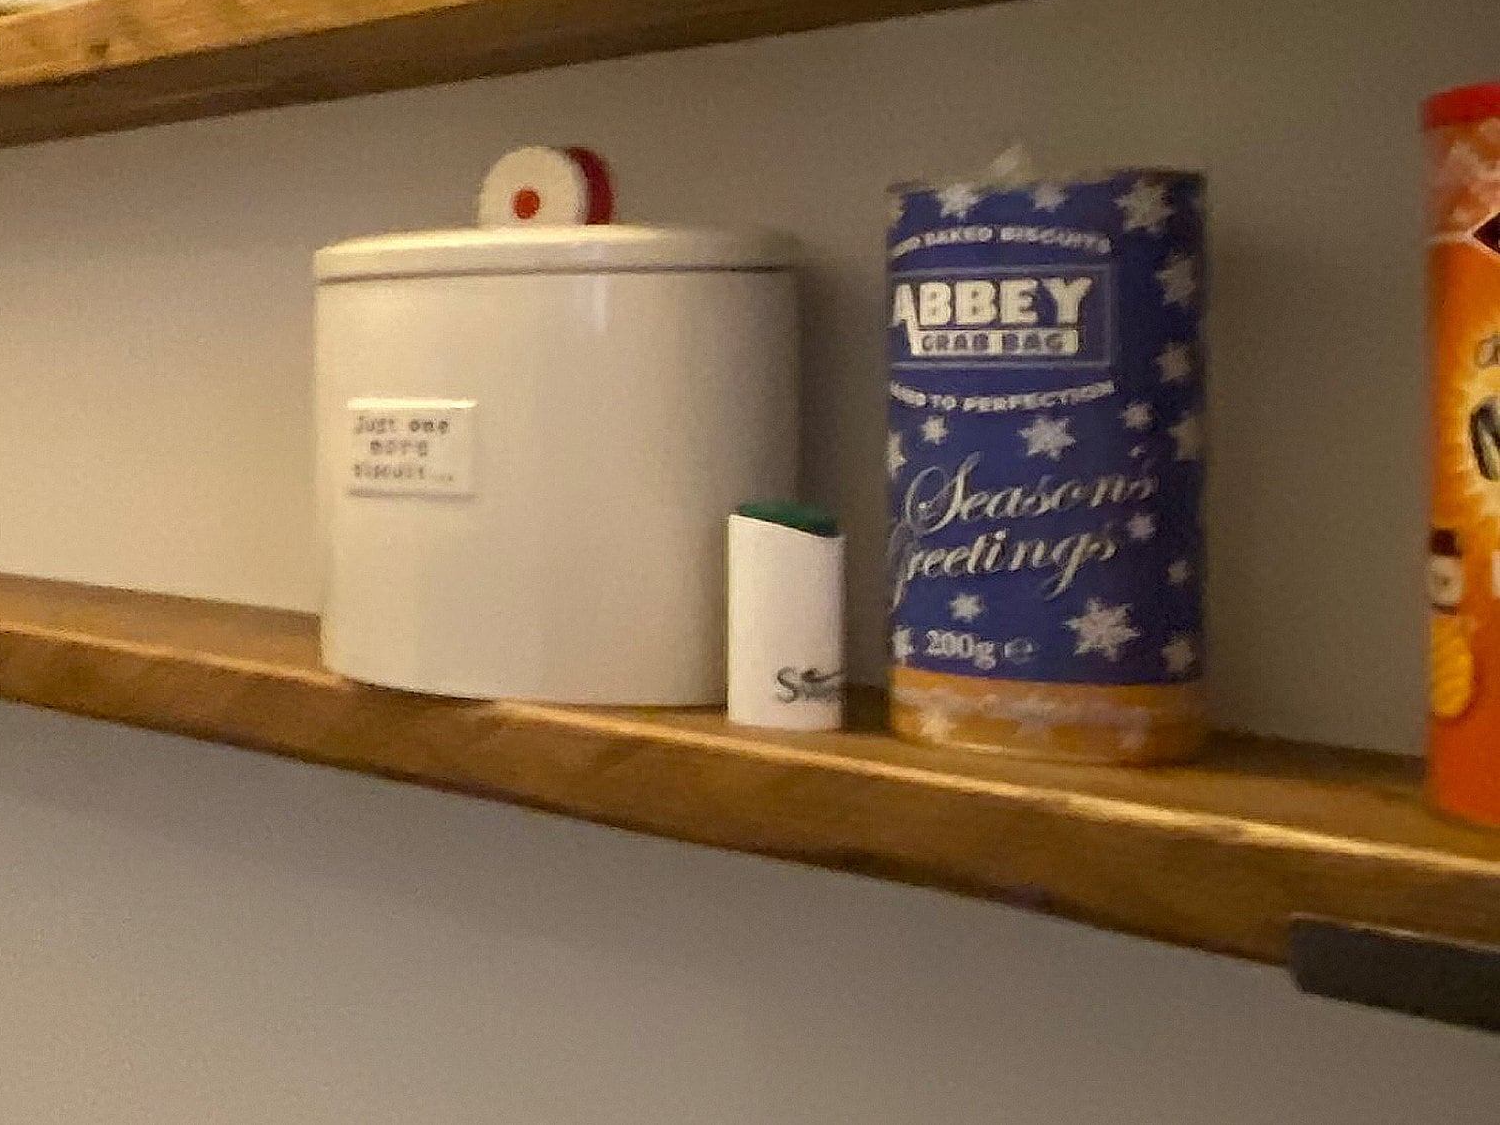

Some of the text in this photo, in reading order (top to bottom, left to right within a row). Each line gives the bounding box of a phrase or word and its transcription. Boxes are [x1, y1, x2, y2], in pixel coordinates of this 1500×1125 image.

[892, 277, 1094, 327] ABBEY
[354, 416, 449, 435] Just one
[368, 439, 429, 457] more
[925, 629, 997, 671] 200g
